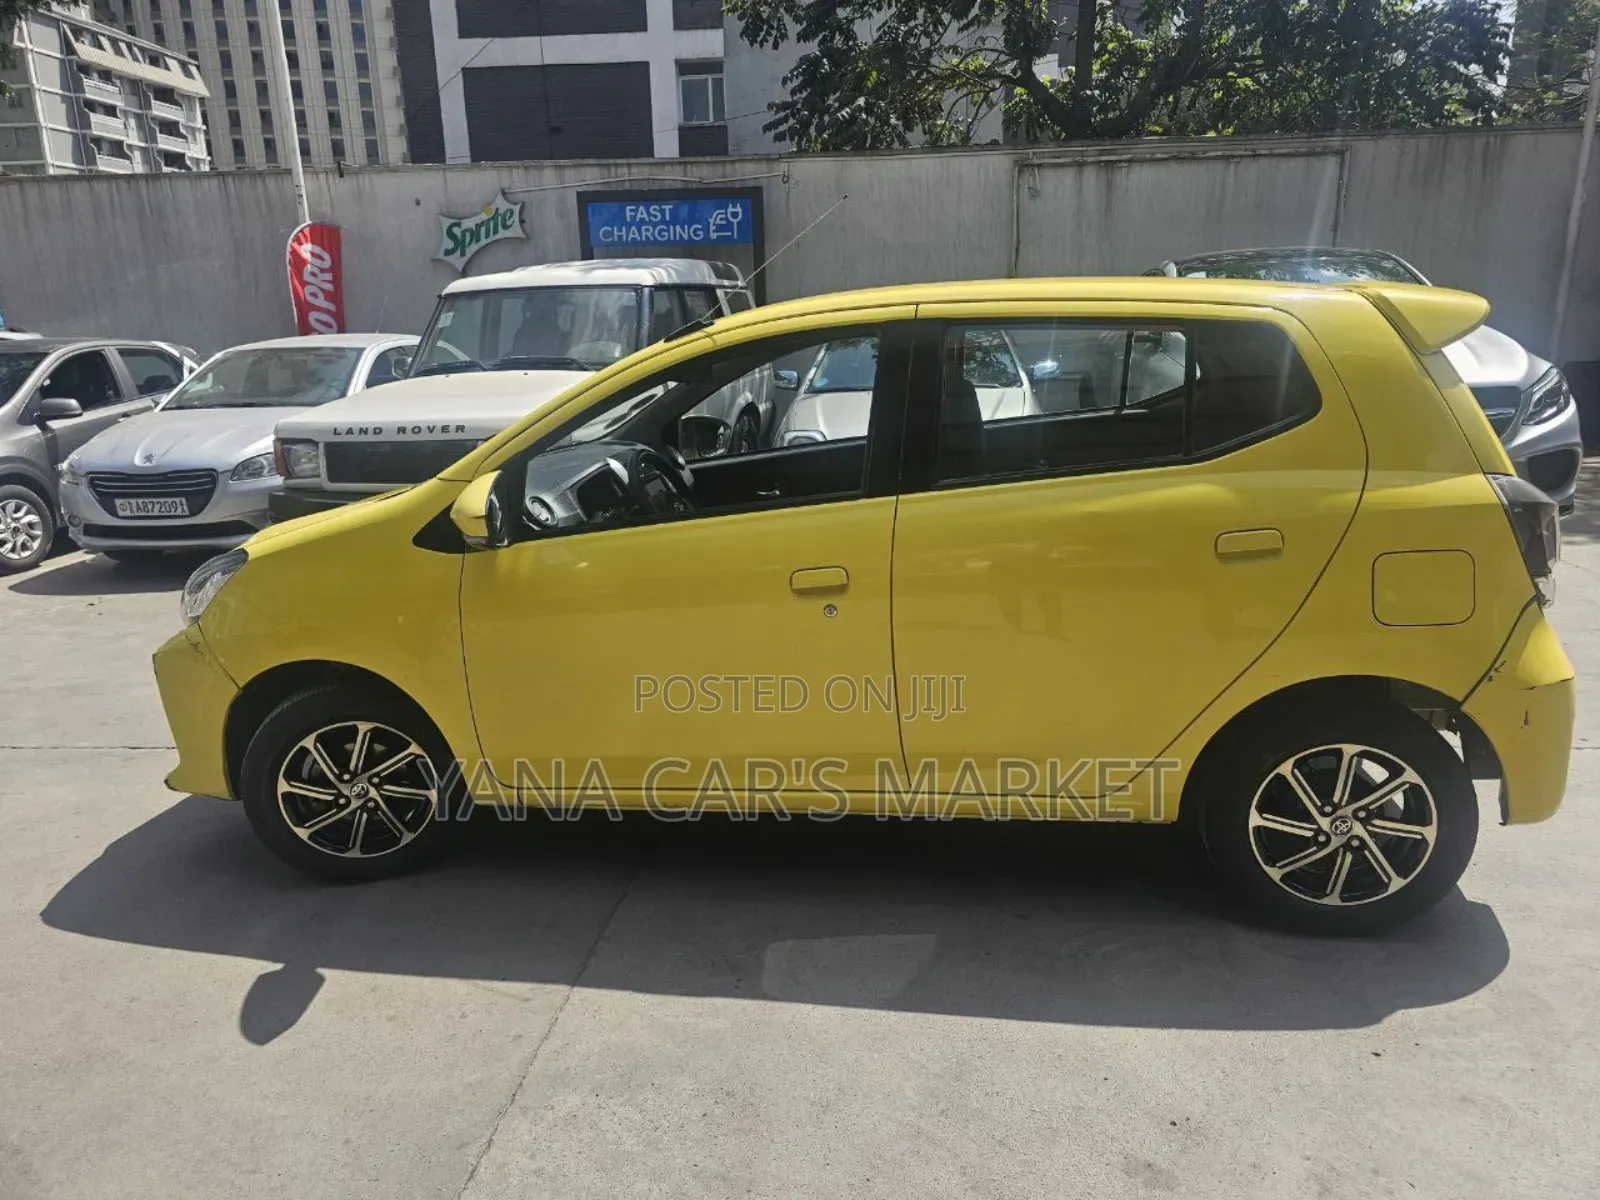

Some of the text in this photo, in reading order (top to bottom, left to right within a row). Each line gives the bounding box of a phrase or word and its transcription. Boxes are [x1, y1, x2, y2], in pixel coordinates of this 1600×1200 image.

[625, 204, 674, 222] FAST
[444, 206, 516, 257] Sprite
[599, 224, 704, 242] CHARGING
[333, 424, 466, 436] LAND ROVER
